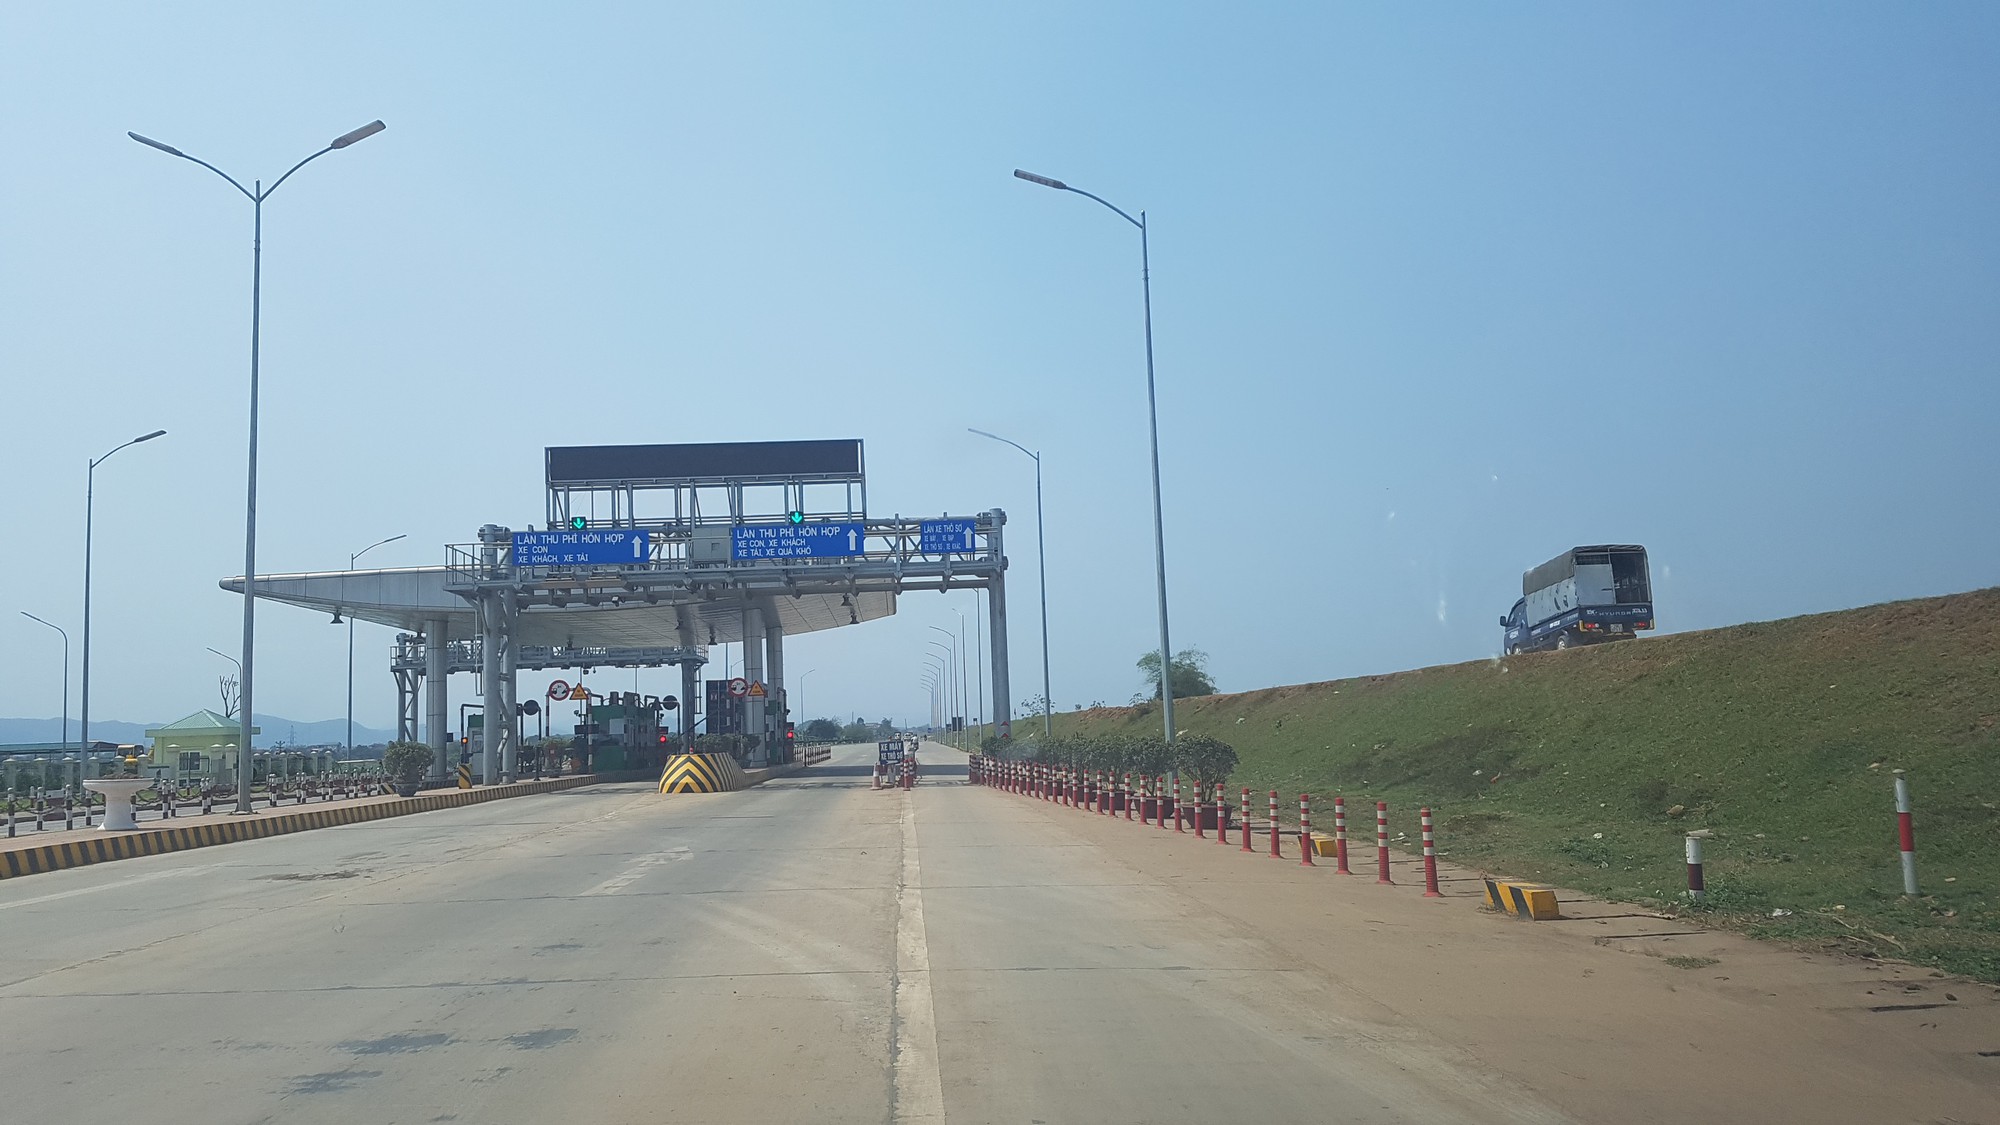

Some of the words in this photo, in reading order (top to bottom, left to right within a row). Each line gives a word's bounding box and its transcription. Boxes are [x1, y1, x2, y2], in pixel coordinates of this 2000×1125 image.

[736, 528, 755, 539] LÀN
[759, 528, 776, 538] THU
[779, 526, 795, 538] PHÍ
[821, 526, 840, 538] HỢP
[935, 524, 942, 533] XE
[517, 533, 537, 545] LÀN
[541, 534, 559, 544] THU
[562, 532, 578, 544] PHÍ
[604, 533, 625, 545] HỢP
[737, 540, 747, 548] XE
[769, 539, 778, 547] XE
[781, 537, 806, 547] KHÁCH
[518, 546, 528, 554] XE
[532, 545, 548, 554] CON
[738, 549, 748, 557] XE
[765, 548, 775, 556] XE
[518, 555, 528, 563] XE
[563, 554, 574, 562] XE
[881, 743, 888, 751] XE
